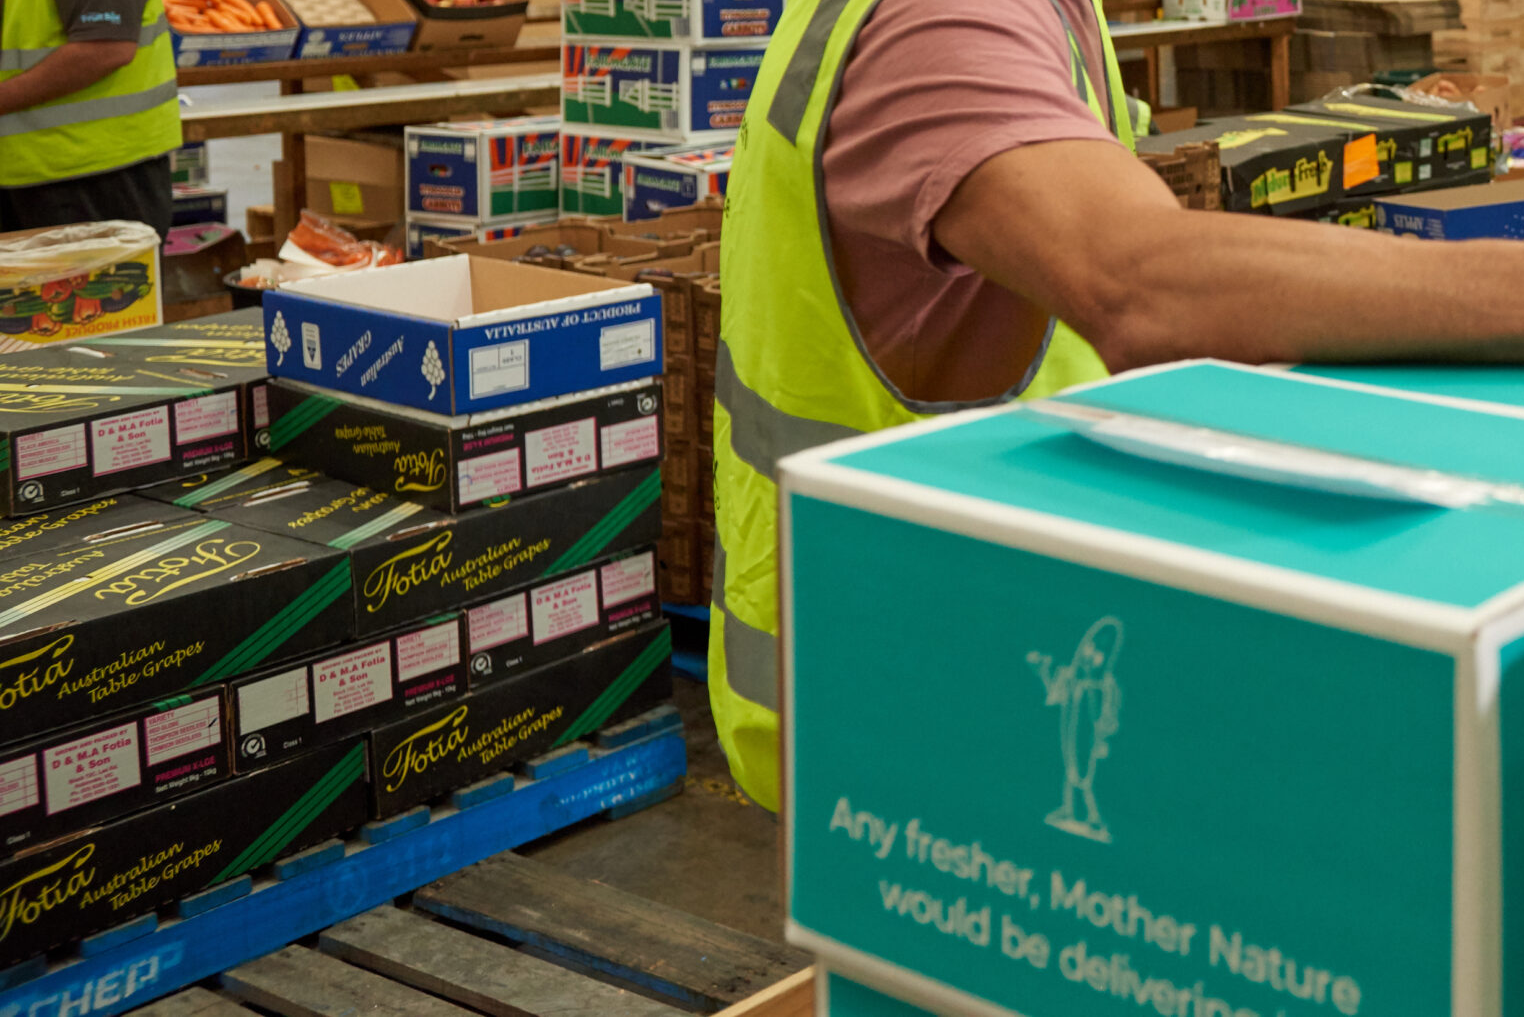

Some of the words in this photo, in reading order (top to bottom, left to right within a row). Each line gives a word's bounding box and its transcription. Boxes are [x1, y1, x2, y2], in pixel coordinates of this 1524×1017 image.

[65, 319, 120, 337] PRODUCE
[122, 313, 156, 328] FRESH
[485, 316, 559, 340] AUSTRALIA
[562, 314, 580, 328] OF
[581, 302, 641, 324] PRODUCT
[335, 330, 373, 377] GRAPES
[361, 335, 405, 387] Australian
[98, 429, 106, 438] D
[108, 426, 116, 435] &
[118, 422, 137, 433] M.A
[139, 417, 164, 429] Fotia
[117, 434, 125, 443] &
[128, 430, 146, 440] Son
[353, 440, 401, 457] Australian
[393, 448, 447, 492] Fotia
[94, 538, 261, 606] Fotia
[363, 531, 453, 613] Fotia
[440, 537, 522, 587] Australian
[462, 564, 502, 591] Table
[503, 538, 552, 572] Grapes
[57, 639, 166, 700] Australian
[88, 671, 142, 703] Table
[143, 640, 206, 679] Grapes
[319, 674, 327, 682] D
[329, 671, 337, 680] &
[340, 664, 358, 675] M.A
[361, 655, 386, 669] Fotia
[339, 678, 346, 686] &
[349, 672, 368, 682] Son
[52, 760, 61, 769] D
[64, 756, 73, 765] &
[76, 748, 99, 761] M.A
[102, 738, 132, 752] Fotia
[383, 705, 469, 793] Fotia
[456, 707, 536, 763] Australian
[479, 735, 517, 765] Table
[518, 705, 565, 741] Grapes
[76, 764, 84, 773] &
[88, 757, 111, 769] Son
[0, 843, 97, 942] Fotia
[79, 840, 185, 910] Australian
[109, 876, 162, 911] Table
[162, 839, 223, 881] Grapes
[829, 796, 898, 859] Any
[903, 817, 1040, 911] fresher,
[1050, 870, 1197, 956] Mother
[1208, 923, 1362, 1016] Nature
[878, 879, 991, 947] would
[1000, 914, 1050, 969] be
